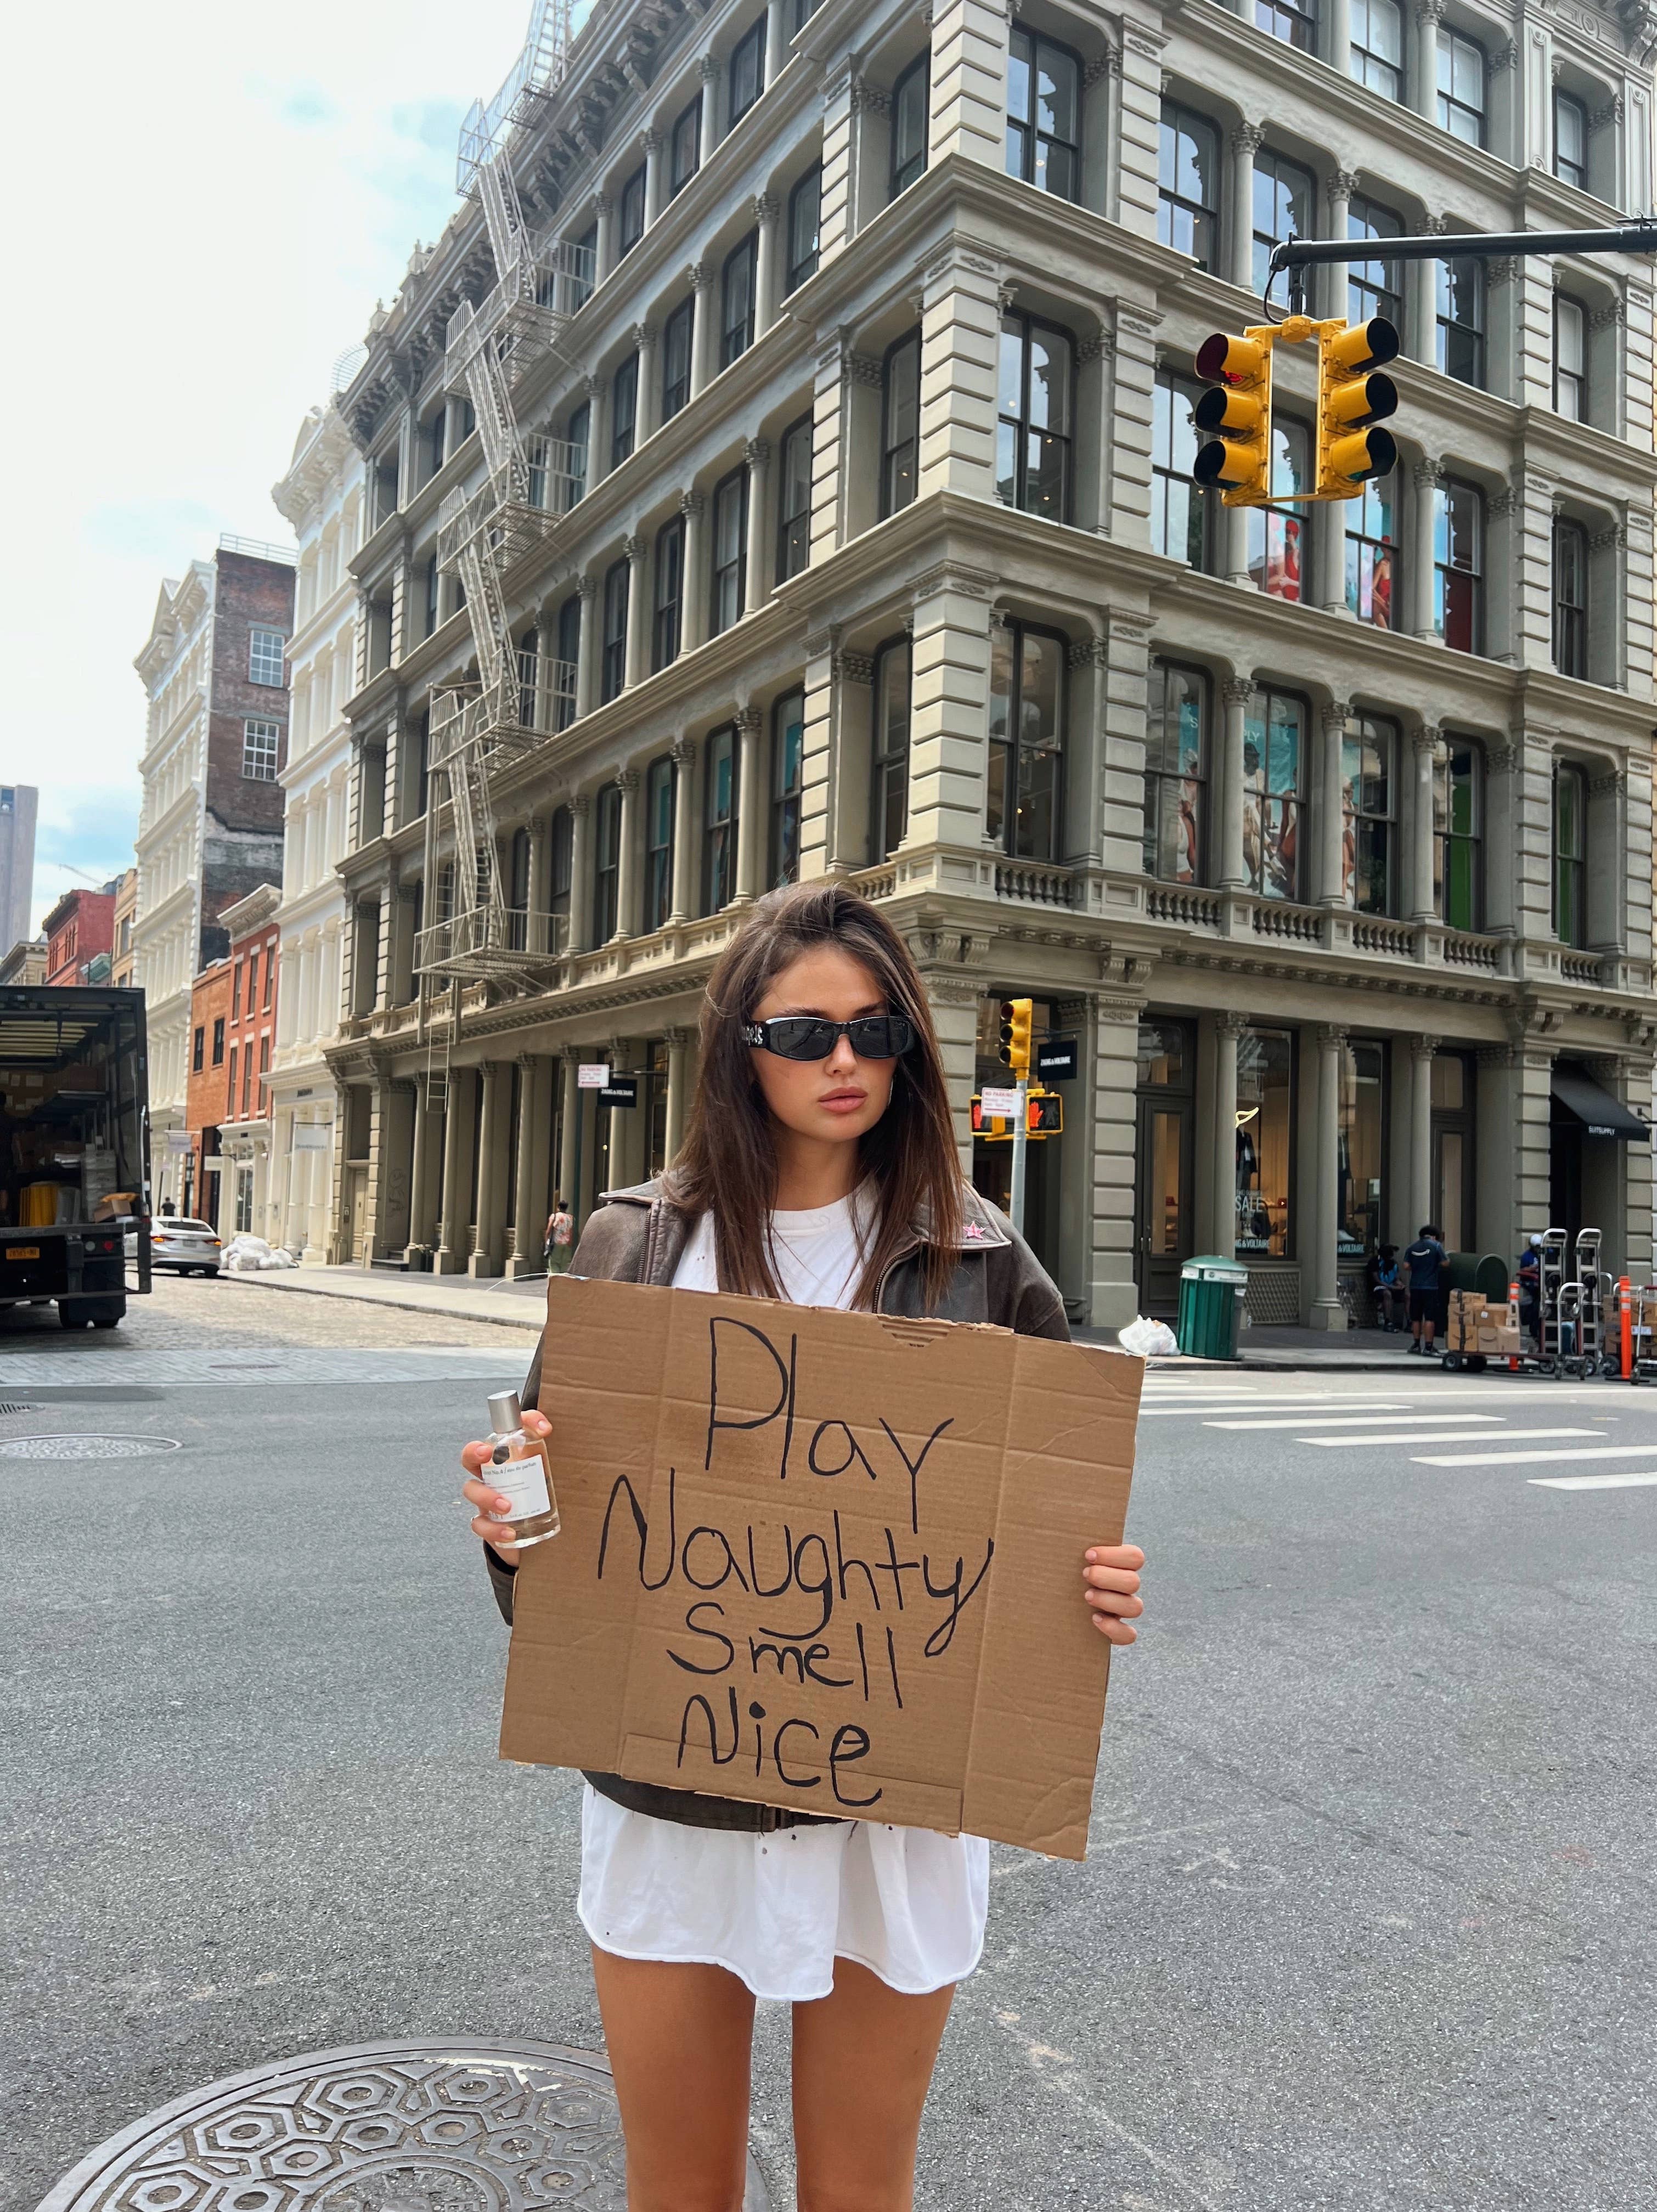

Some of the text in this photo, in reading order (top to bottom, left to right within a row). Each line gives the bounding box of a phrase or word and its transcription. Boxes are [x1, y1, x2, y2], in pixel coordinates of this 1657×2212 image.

[1236, 1195, 1263, 1212] SALE
[1247, 1239, 1270, 1249] VOLTAIRE
[598, 1467, 995, 1658] Naughty
[666, 1602, 903, 1709] Smell
[677, 1686, 883, 1807] Nice
